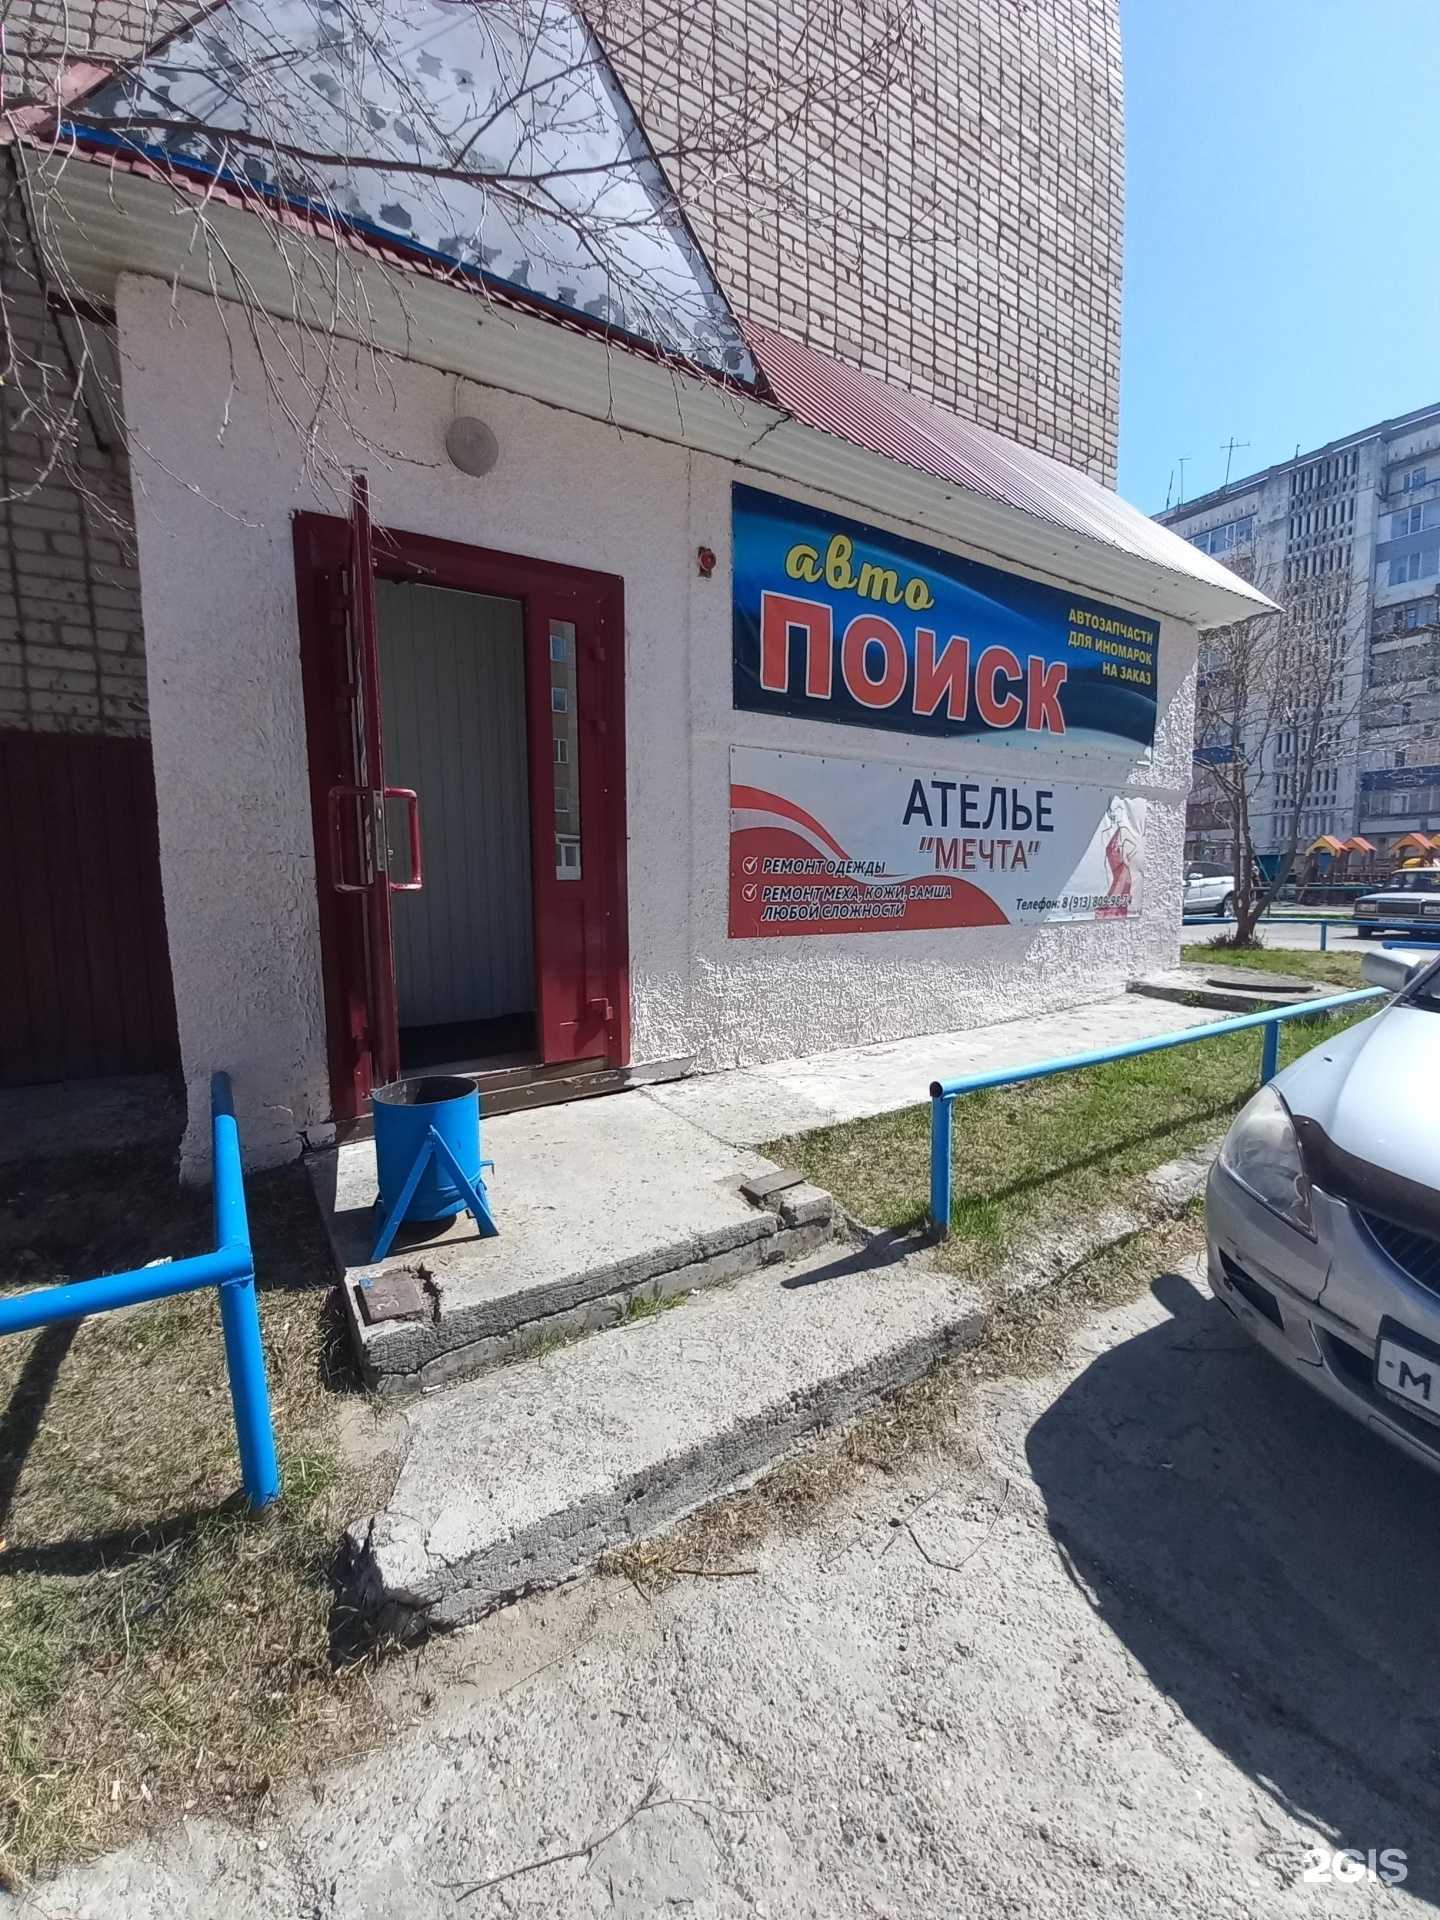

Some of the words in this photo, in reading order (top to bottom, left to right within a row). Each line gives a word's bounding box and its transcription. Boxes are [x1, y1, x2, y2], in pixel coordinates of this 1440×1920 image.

[785, 533, 935, 611] авто
[1068, 608, 1153, 645] АВТОЗАПЧАСТИ
[760, 589, 1069, 735] ПОИСК
[1068, 630, 1092, 649] ДЛЯ
[1095, 638, 1152, 665] ИНОМАРОК
[1102, 662, 1117, 677] НА
[1120, 666, 1151, 685] ЗАКАЗ
[902, 779, 1054, 832] АТЕЛЬЕ
[762, 857, 825, 875] РЕМОНТ
[825, 859, 886, 878] ОДЕЖДЫ
[919, 836, 1040, 872] "МЕЧТА"
[761, 885, 824, 902] РЕМОНТ
[823, 885, 863, 902] МЕХА,
[865, 885, 908, 902] КОЖИ,
[909, 884, 952, 899] ЗАМША
[1016, 897, 1060, 913] Телефон:
[1061, 897, 1069, 908] 8
[1069, 895, 1091, 912] (913)
[761, 901, 821, 921] ЛЮБОЙ
[821, 902, 906, 919] СЛОЖНОСТИ
